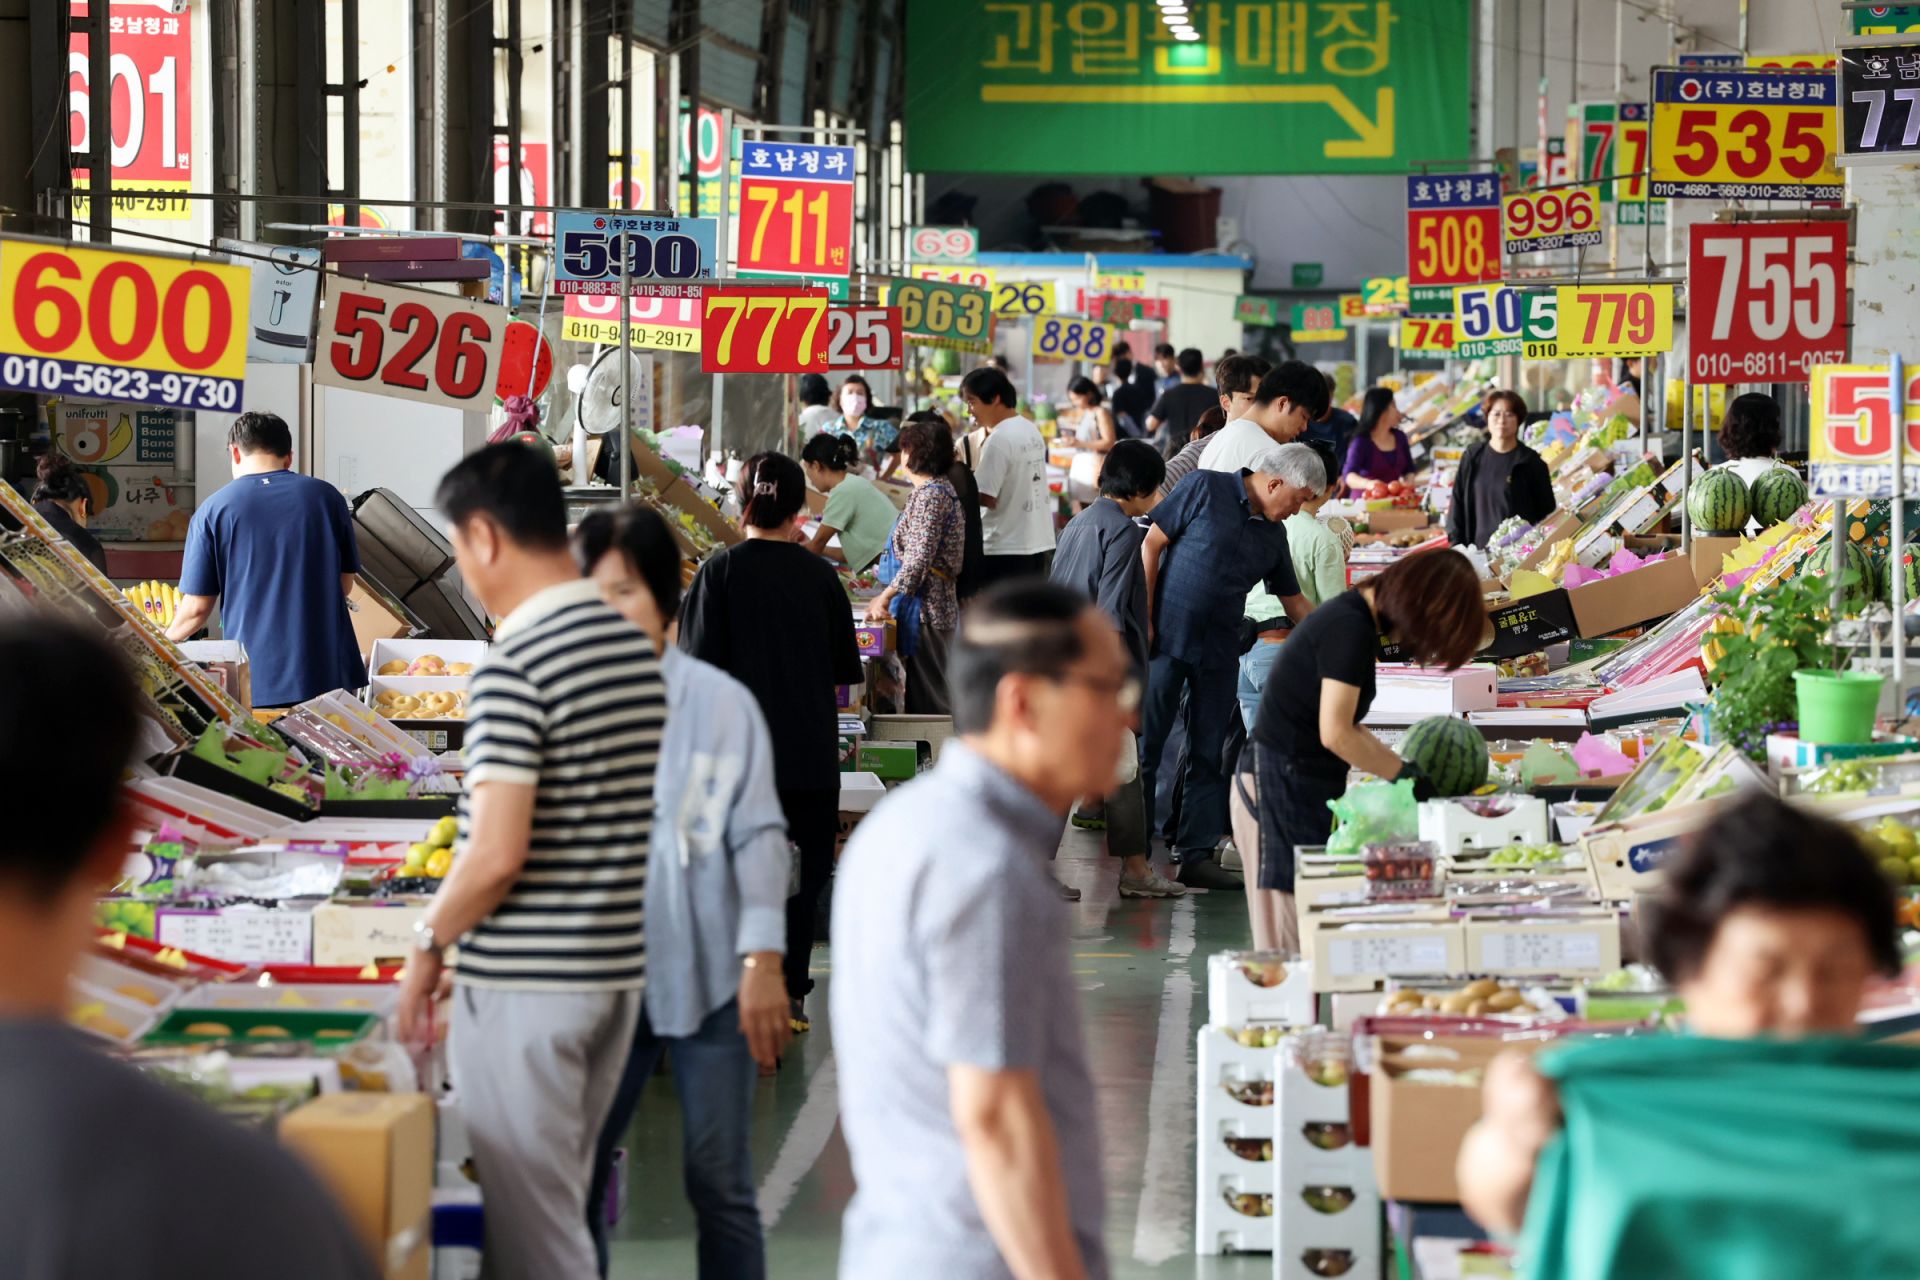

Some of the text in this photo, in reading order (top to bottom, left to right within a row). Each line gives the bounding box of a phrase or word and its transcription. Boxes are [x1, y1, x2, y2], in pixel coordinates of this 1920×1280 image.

[109, 16, 180, 36] 호남청과
[748, 148, 848, 176] 호남청과
[1673, 109, 1826, 179] 535
[1413, 179, 1495, 203] 호남청과
[1506, 191, 1593, 237] 996
[747, 186, 829, 266] 711
[914, 228, 975, 257] 69
[1418, 215, 1485, 277] 508
[1507, 231, 1601, 254] 010-3207-6600
[562, 231, 702, 279] 590
[12, 251, 233, 371] 600
[896, 285, 985, 337] 663
[1703, 236, 1836, 341] 755
[705, 296, 828, 366] 777
[1039, 320, 1105, 359] 888
[1576, 292, 1656, 345] 779
[329, 291, 492, 400] 526
[2, 354, 238, 410] 010-5623-9730
[65, 407, 109, 420] unifrutti
[126, 487, 160, 505] 나주
